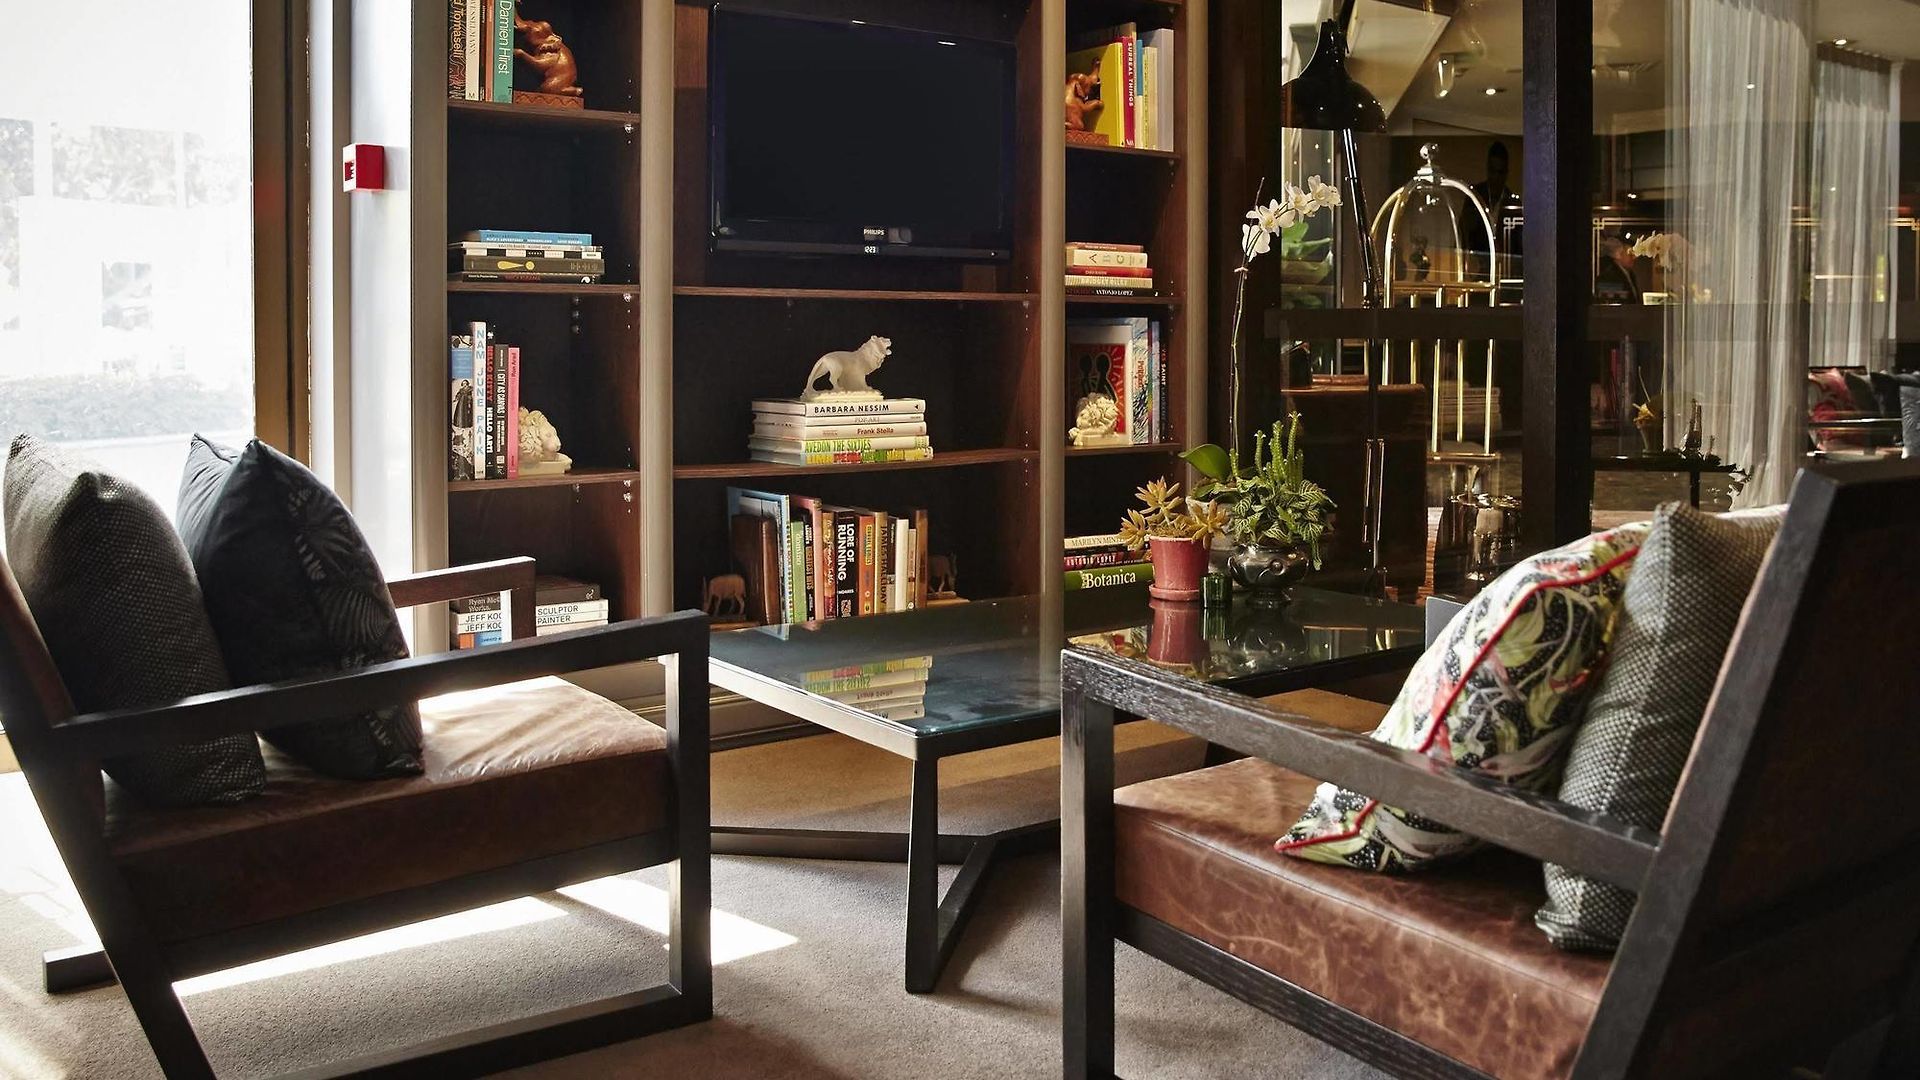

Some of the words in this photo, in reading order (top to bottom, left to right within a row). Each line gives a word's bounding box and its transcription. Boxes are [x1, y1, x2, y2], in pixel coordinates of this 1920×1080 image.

[452, 8, 464, 59] Tomaselli
[499, 1, 512, 46] Damien
[498, 48, 510, 75] Hirst
[863, 228, 885, 236] PHILIPS
[476, 329, 485, 360] NAM
[476, 368, 484, 407] JUNE
[496, 373, 506, 386] CITY
[496, 386, 505, 394] AS
[496, 394, 505, 414] CANVAS
[814, 405, 855, 414] BARBARA
[858, 404, 889, 412] NESSIM
[486, 407, 494, 432] HELLO
[476, 416, 484, 455] PAIK
[805, 440, 831, 453] AVEDON
[833, 440, 845, 452] THE
[847, 438, 871, 452] SIXTIES
[847, 523, 855, 547] LORE
[837, 524, 847, 581] RUNNING
[847, 549, 855, 563] OF
[1085, 569, 1136, 589] Botanica
[465, 614, 486, 623] JEFF
[537, 605, 579, 616] SCULPTOR
[537, 615, 571, 625] PAINTER
[465, 623, 486, 632] JEFF
